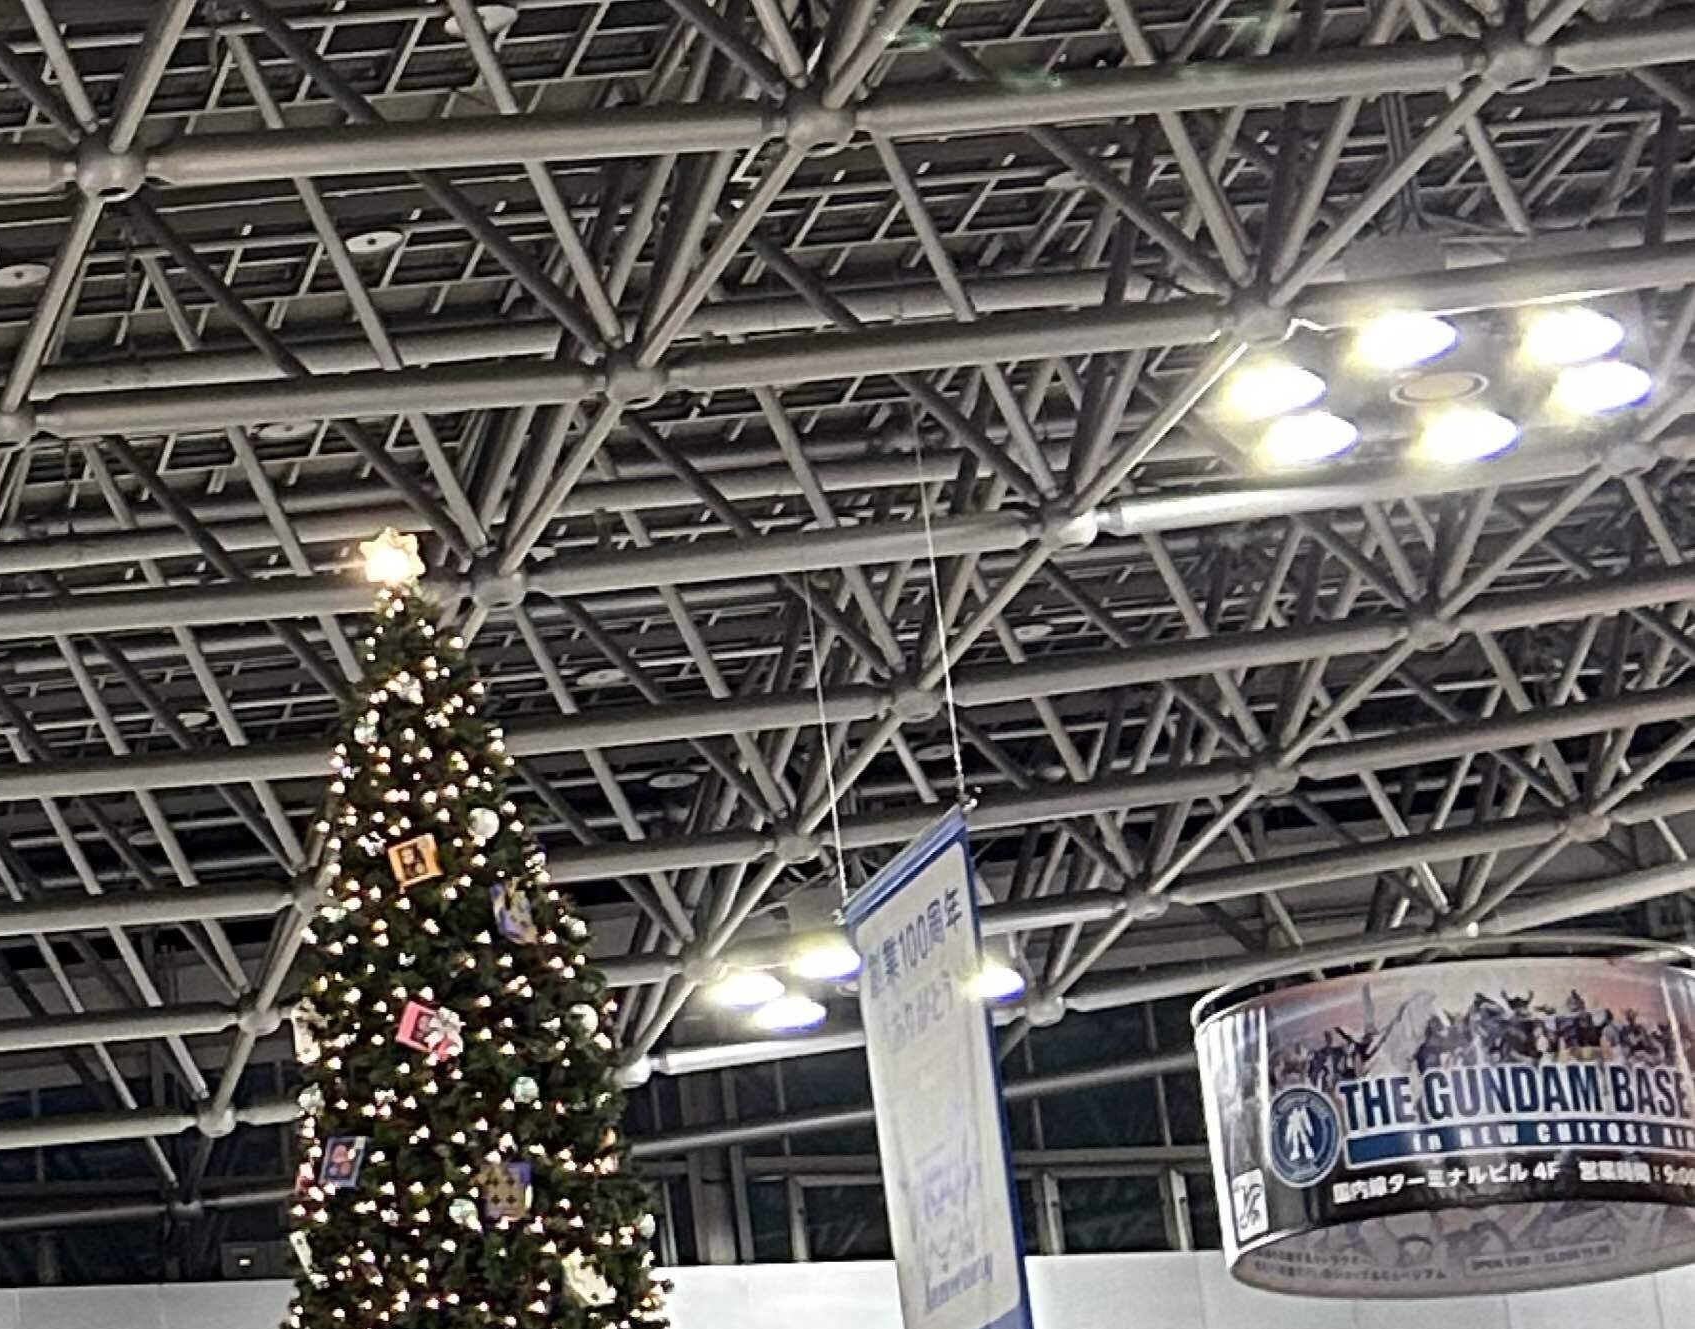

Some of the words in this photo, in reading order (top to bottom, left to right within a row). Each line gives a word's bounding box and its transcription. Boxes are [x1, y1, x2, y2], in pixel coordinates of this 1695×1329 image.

[1339, 1076, 1411, 1131] THE
[1424, 1064, 1604, 1120] GUNDAM
[1610, 1065, 1691, 1119] BASE
[1462, 1123, 1518, 1147] NEW
[1536, 1120, 1651, 1145] CHITOSE
[1533, 1160, 1561, 1181] 4F
